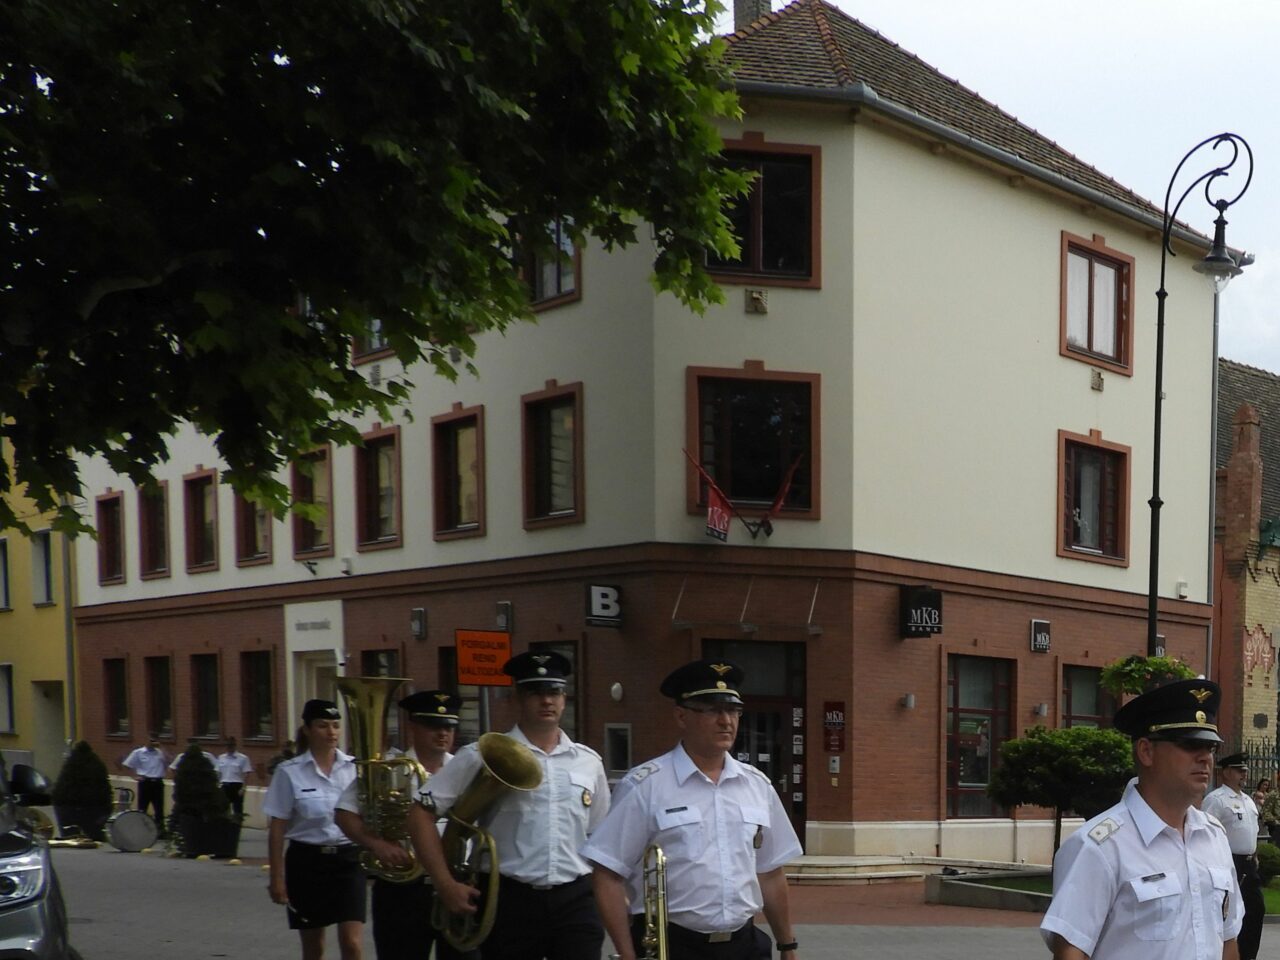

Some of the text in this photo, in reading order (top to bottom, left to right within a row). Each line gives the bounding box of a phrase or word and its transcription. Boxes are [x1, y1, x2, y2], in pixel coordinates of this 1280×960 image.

[591, 585, 620, 617] B
[911, 606, 939, 626] MKB
[1036, 632, 1050, 645] MKB
[826, 710, 844, 723] MKB
